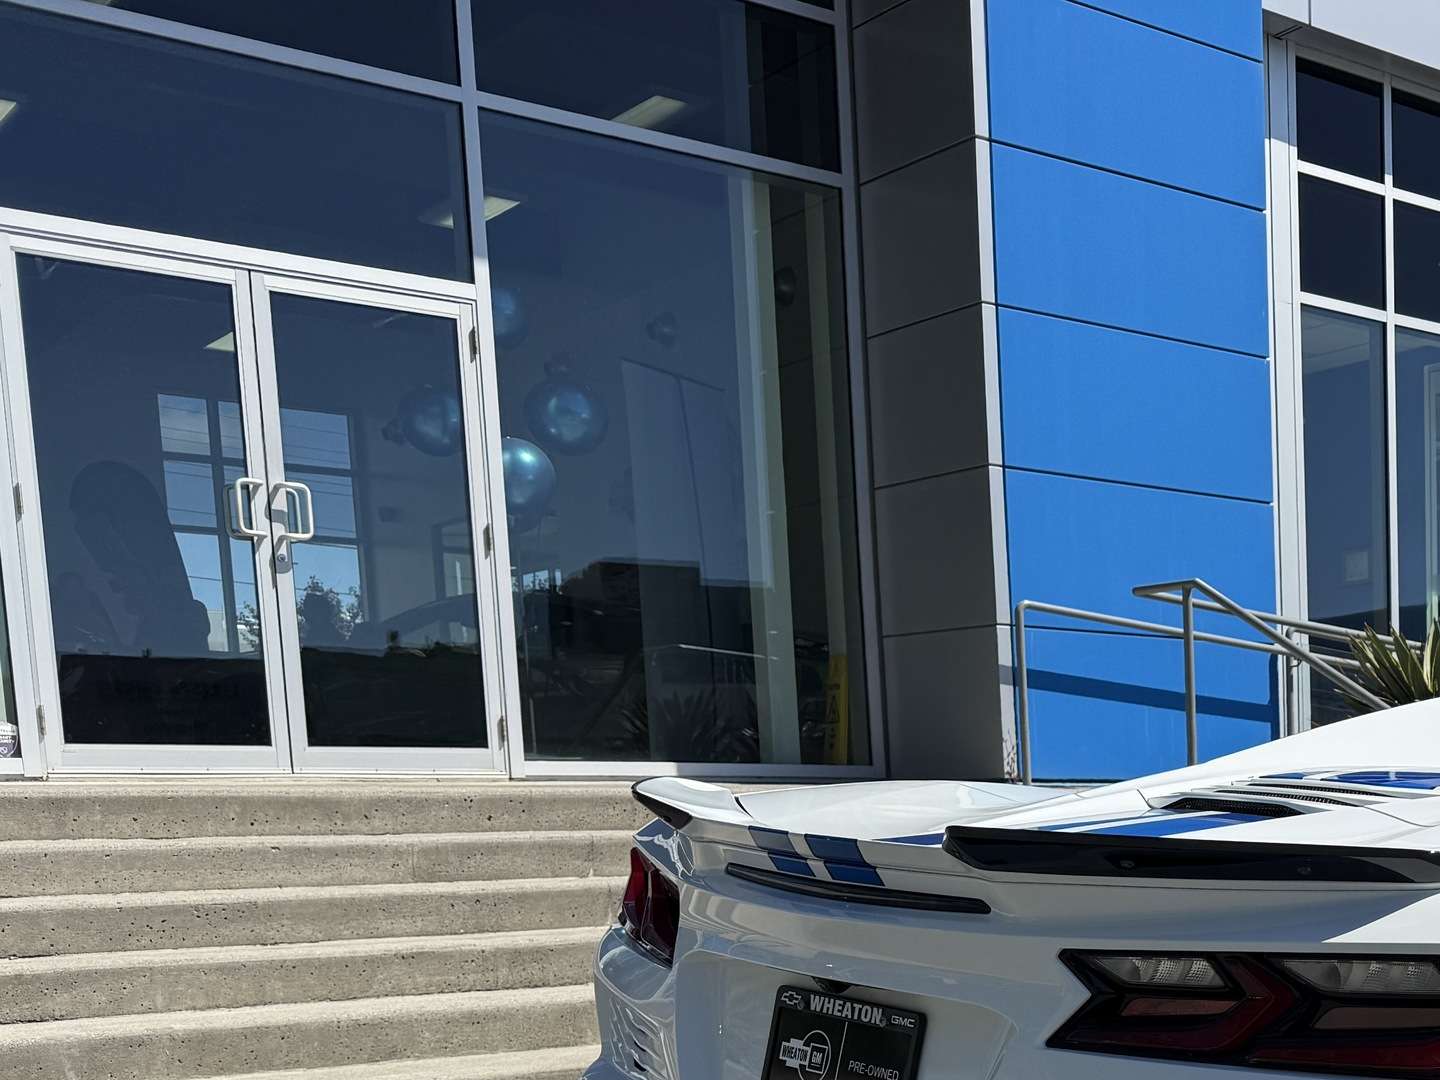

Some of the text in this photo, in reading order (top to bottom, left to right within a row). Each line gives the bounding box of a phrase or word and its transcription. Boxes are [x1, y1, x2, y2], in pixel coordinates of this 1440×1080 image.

[810, 994, 883, 1025] WHEATON
[891, 1015, 916, 1028] GMC
[812, 1051, 823, 1064] GM
